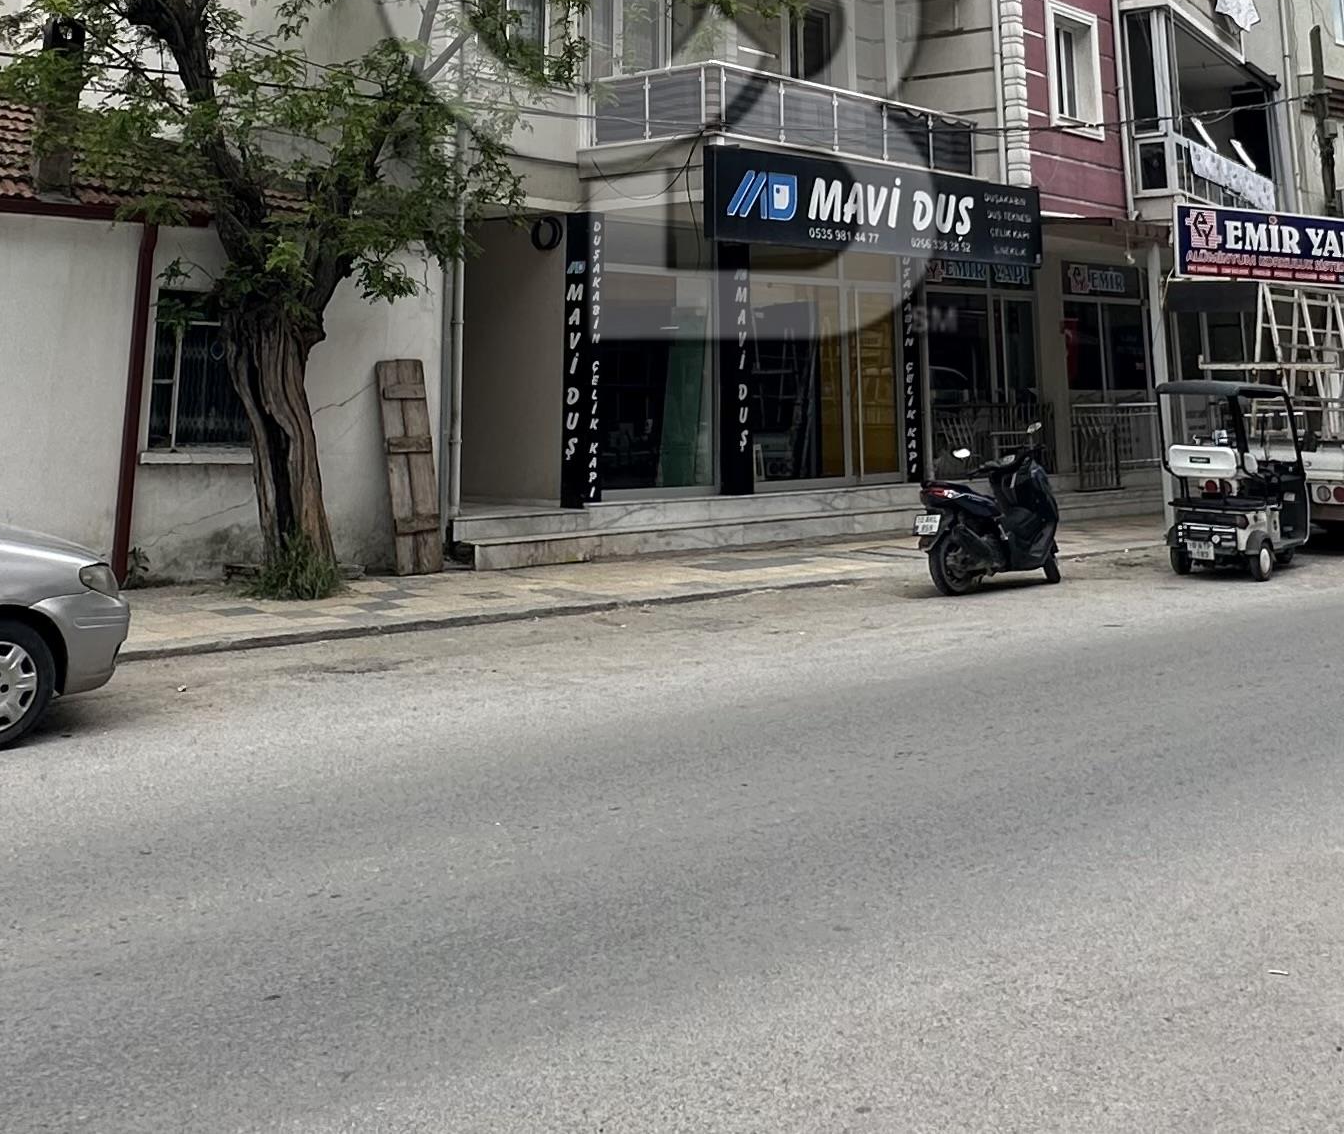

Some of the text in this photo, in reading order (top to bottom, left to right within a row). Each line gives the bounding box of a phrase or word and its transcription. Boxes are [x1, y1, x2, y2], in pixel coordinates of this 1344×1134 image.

[807, 177, 975, 241] MAVİ DUŞ
[808, 227, 880, 244] 0535 981 44 77
[1223, 215, 1301, 255] EMİR
[592, 221, 601, 344] DUŞAKABİN
[903, 257, 914, 347] UŞAKABİN
[566, 283, 584, 375] MAVİ
[735, 287, 749, 452] MAVİ DUŞ
[565, 387, 580, 461] DUŞ
[907, 427, 918, 474] KAPI
[588, 442, 599, 498] KAPI
